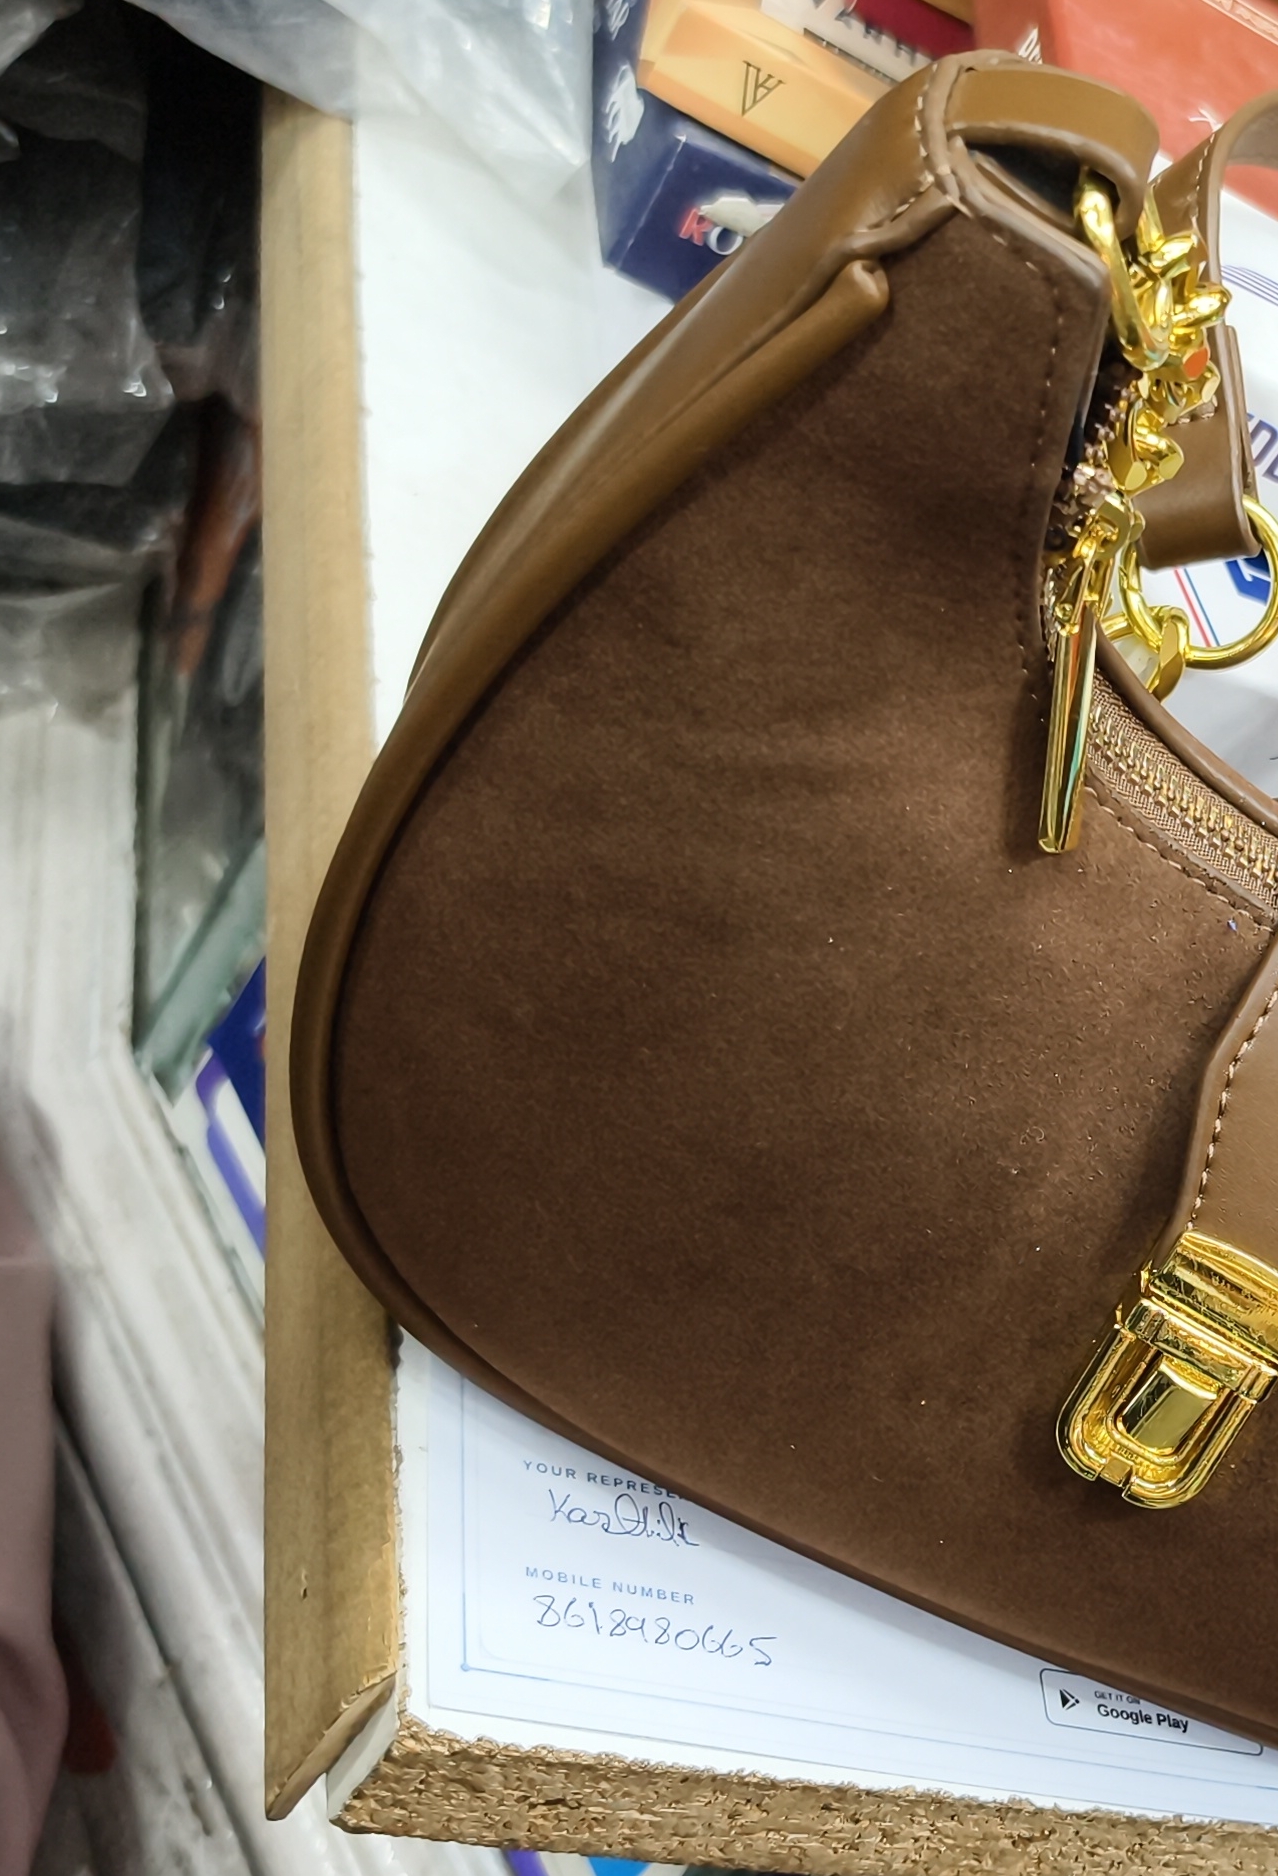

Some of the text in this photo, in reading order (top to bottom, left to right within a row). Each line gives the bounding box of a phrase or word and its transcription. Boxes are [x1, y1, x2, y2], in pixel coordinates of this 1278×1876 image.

[523, 1459, 577, 1480] YOUR
[525, 1566, 695, 1605] MOBILE NUMBER
[1097, 1703, 1189, 1734] Google Play
